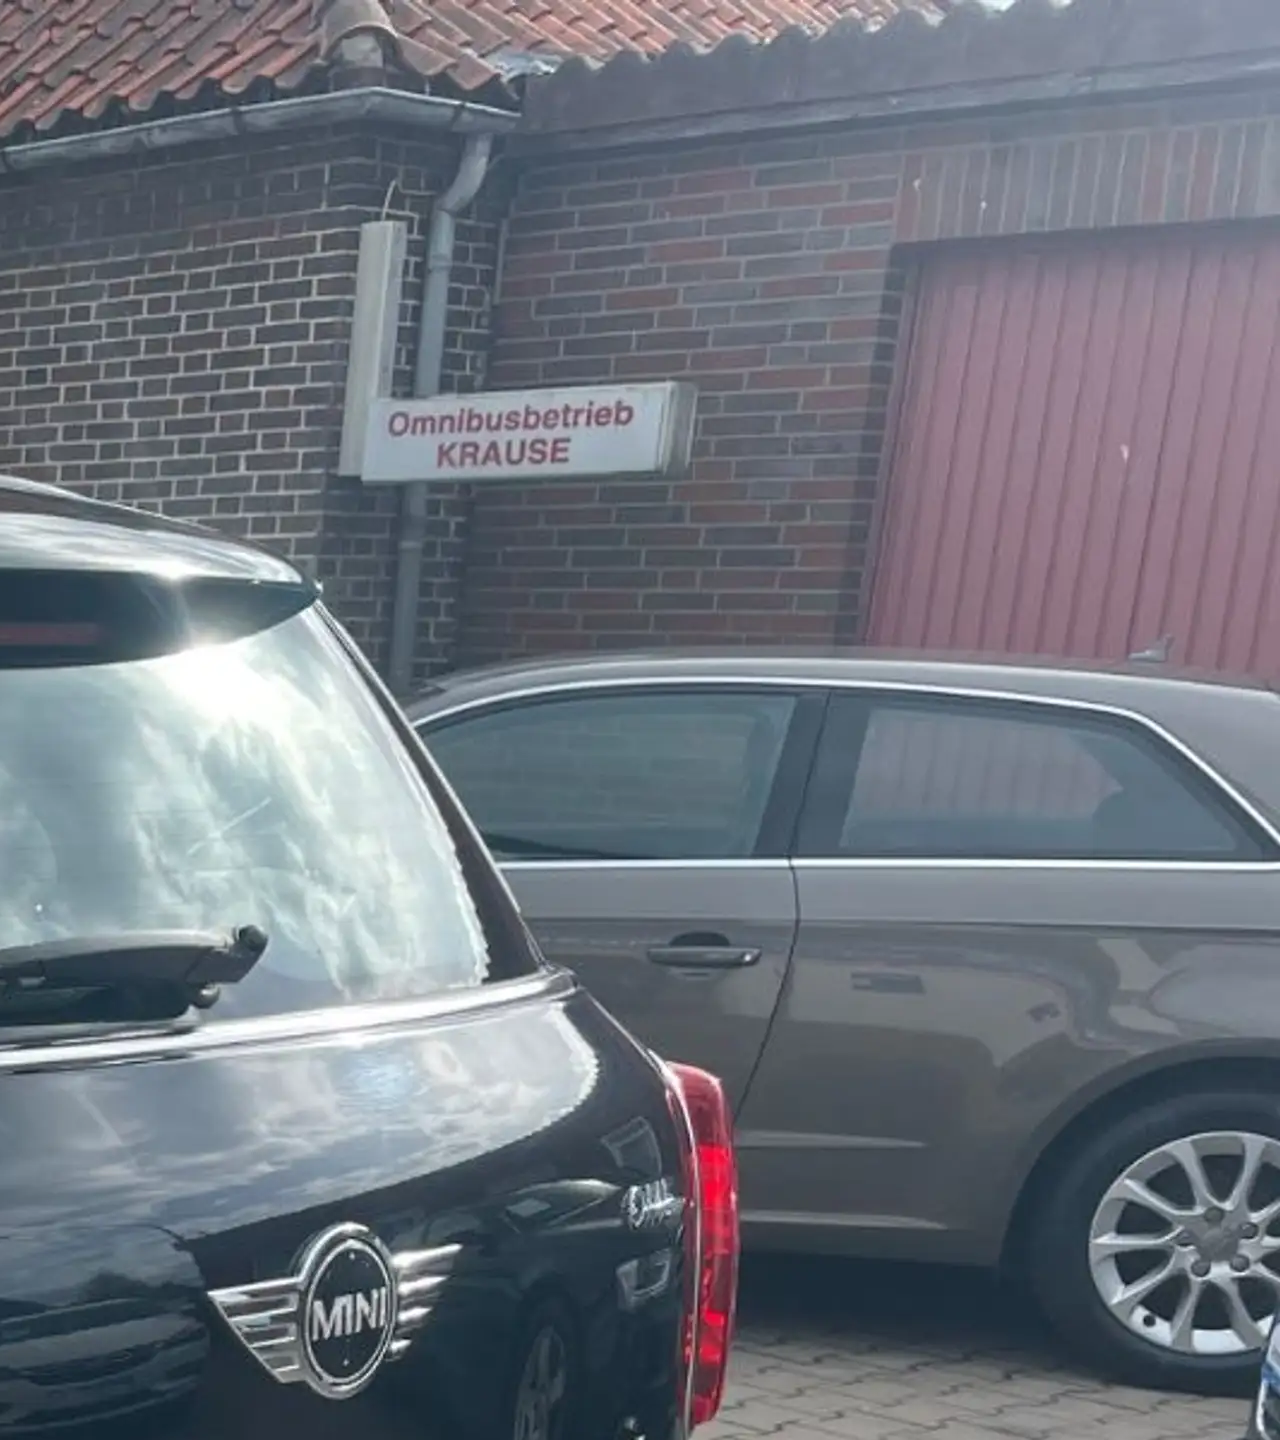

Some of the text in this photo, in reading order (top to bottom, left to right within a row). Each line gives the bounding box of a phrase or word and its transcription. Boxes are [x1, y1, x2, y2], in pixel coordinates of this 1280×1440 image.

[388, 401, 635, 437] Omnibusbetrieb
[436, 437, 572, 469] KRAUSE
[311, 1286, 387, 1343] MINI
